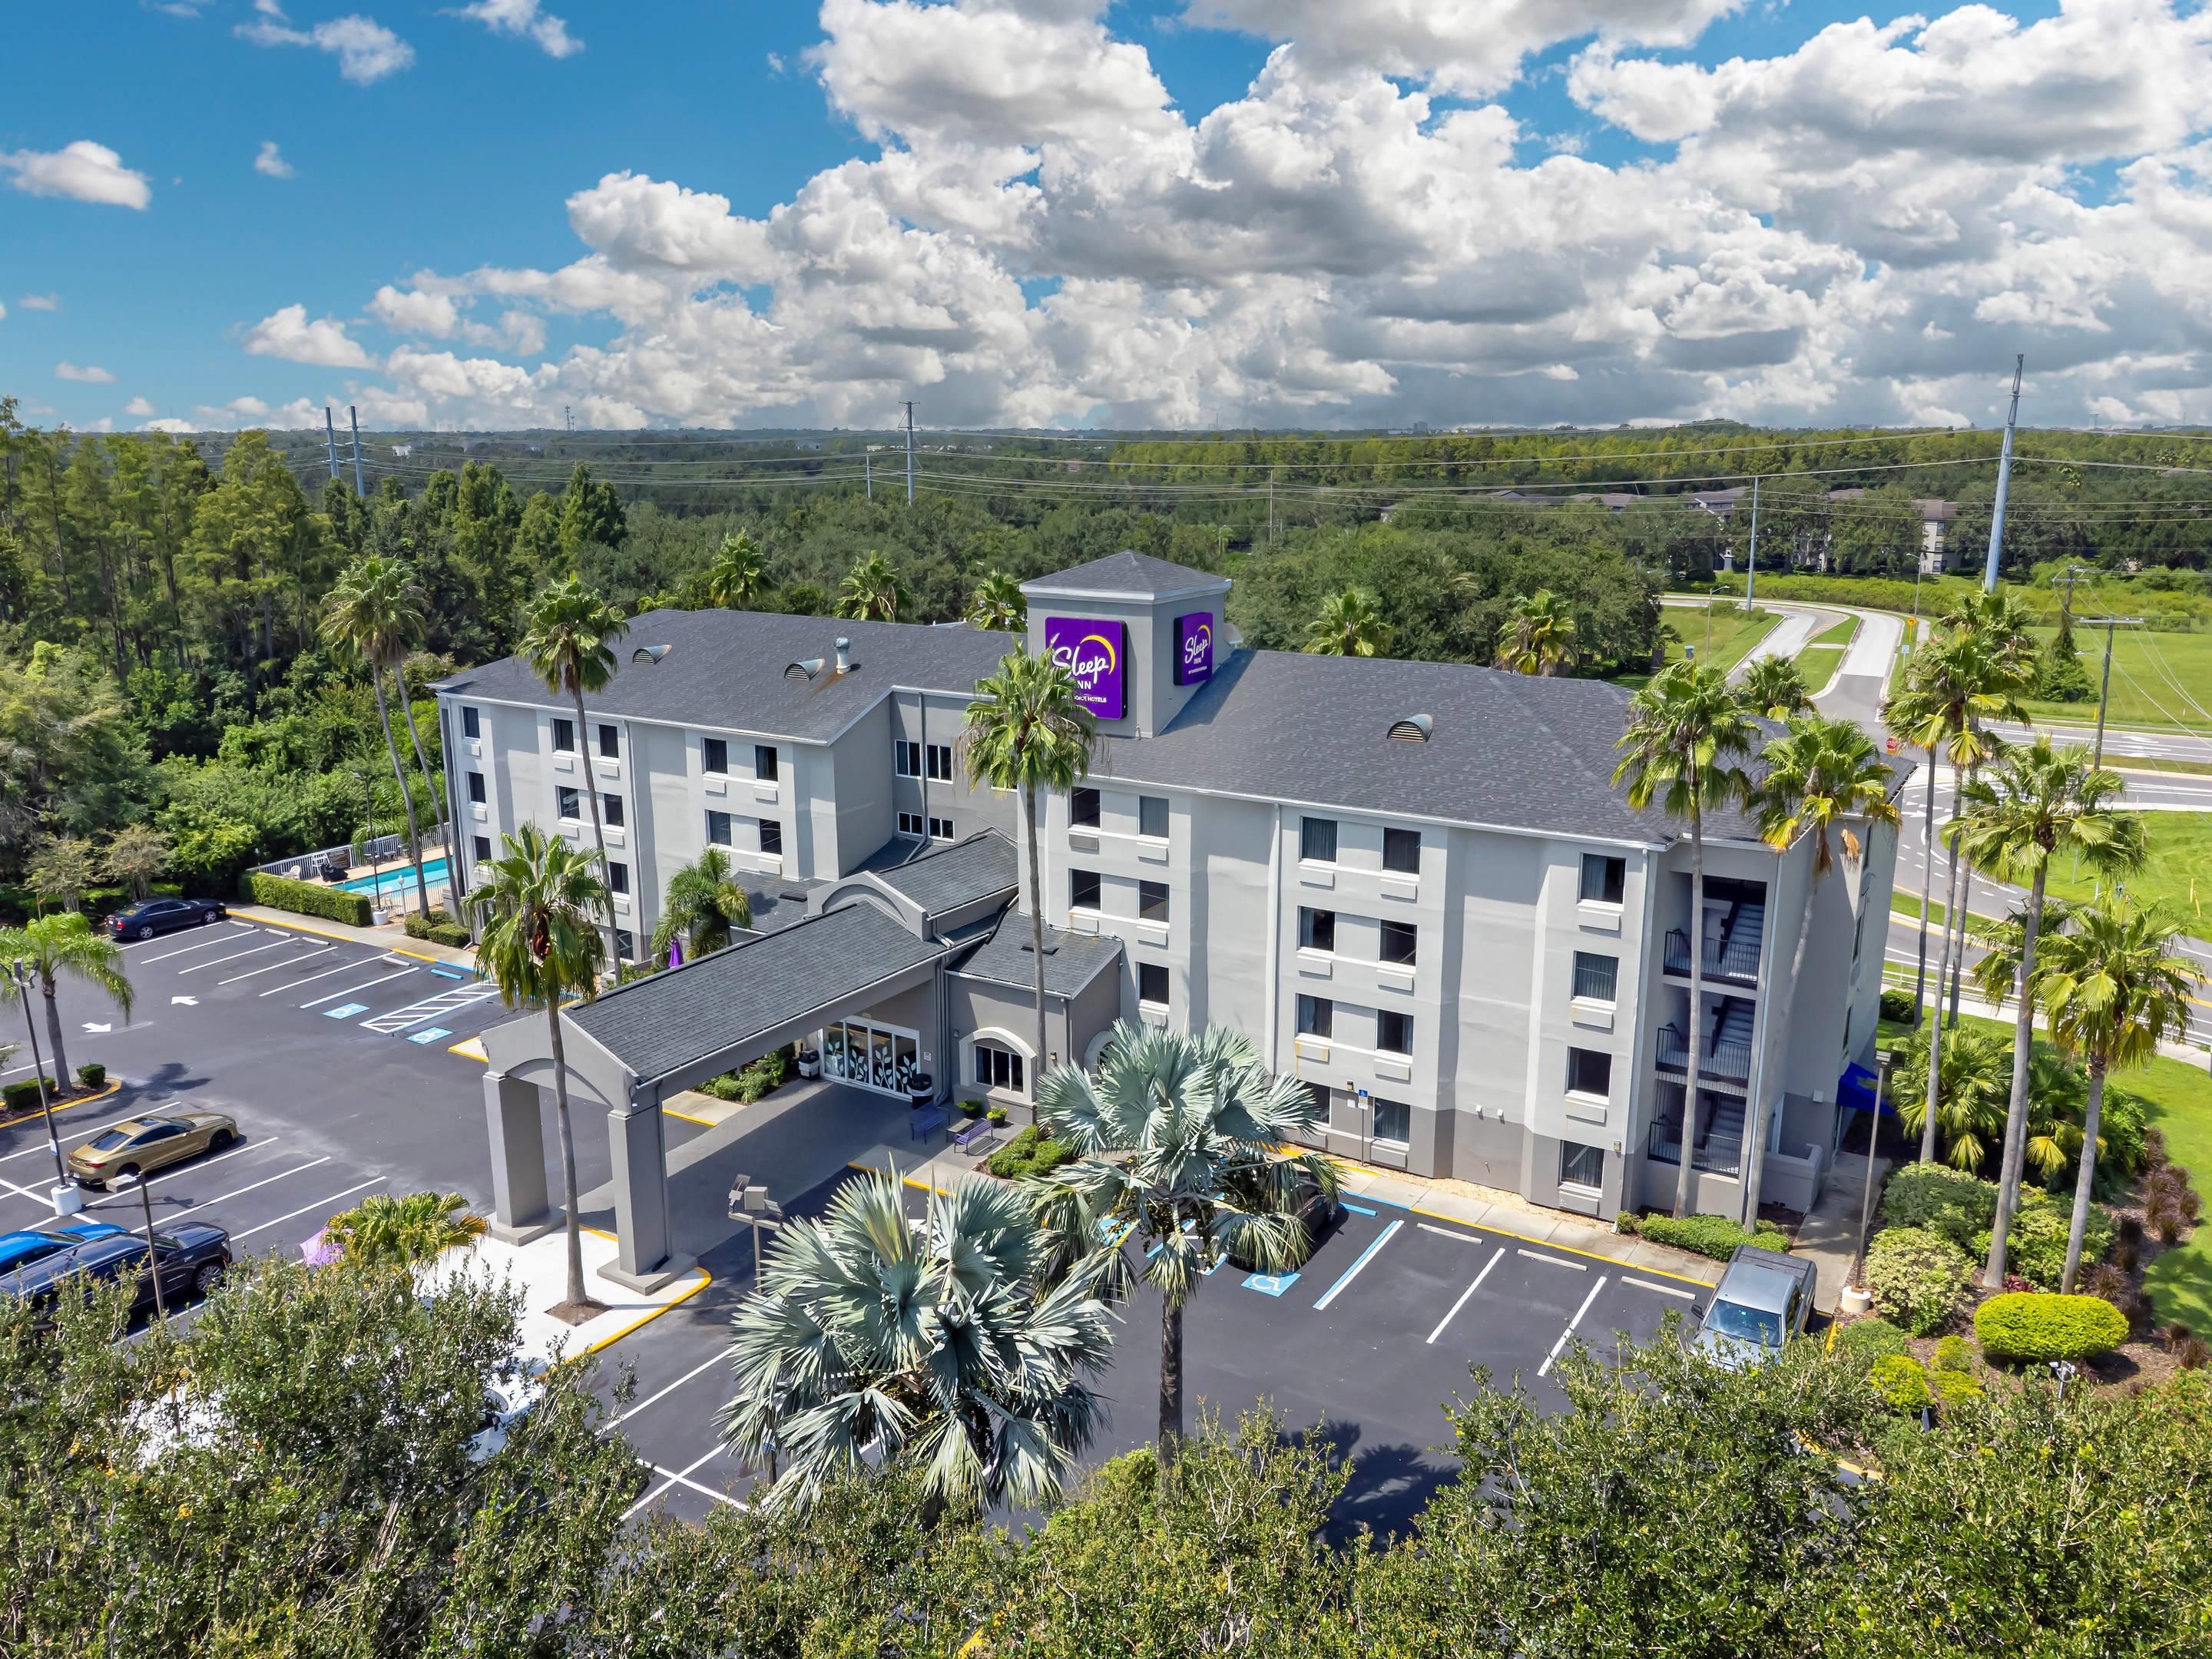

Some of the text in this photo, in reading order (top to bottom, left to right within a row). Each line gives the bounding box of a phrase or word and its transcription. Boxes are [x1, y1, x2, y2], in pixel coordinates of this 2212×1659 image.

[1185, 635, 1207, 664] Sleep
[1052, 646, 1109, 684] Sleep
[1075, 680, 1091, 690] NN
